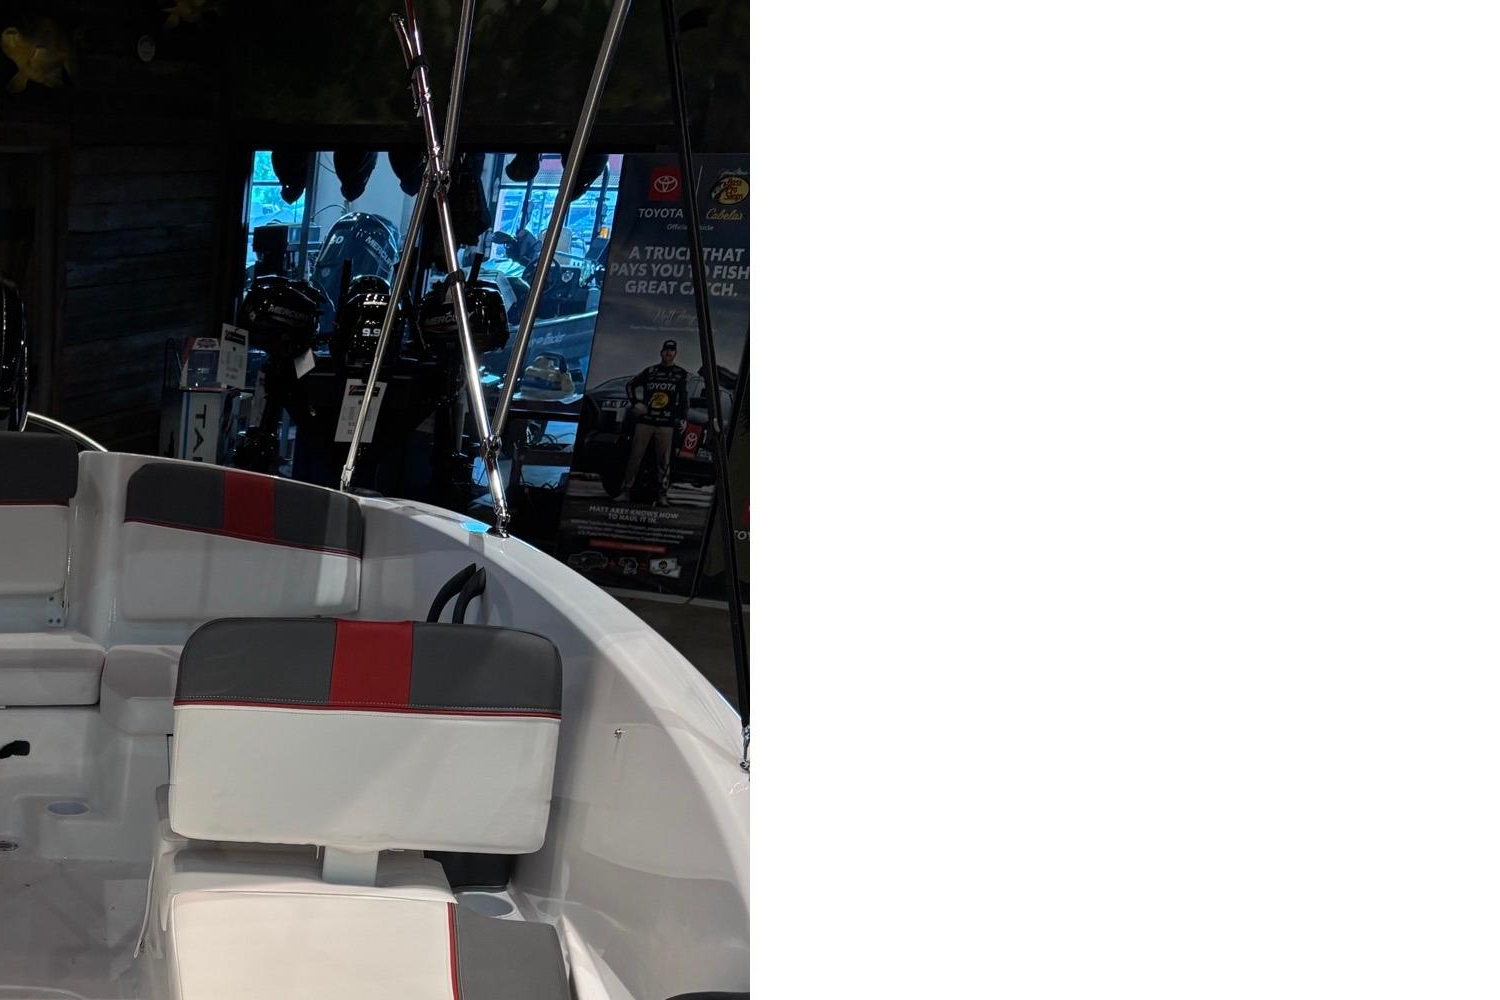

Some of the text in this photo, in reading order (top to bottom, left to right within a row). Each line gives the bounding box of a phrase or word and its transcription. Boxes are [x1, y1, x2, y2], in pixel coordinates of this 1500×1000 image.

[638, 208, 684, 219] TOYOTA
[666, 224, 690, 233] Officia
[628, 245, 641, 260] A
[702, 248, 746, 262] THAT
[609, 263, 648, 277] PAYS
[651, 264, 685, 278] YOU
[625, 280, 738, 297] GREAT CCH.
[362, 328, 381, 337] 9.9
